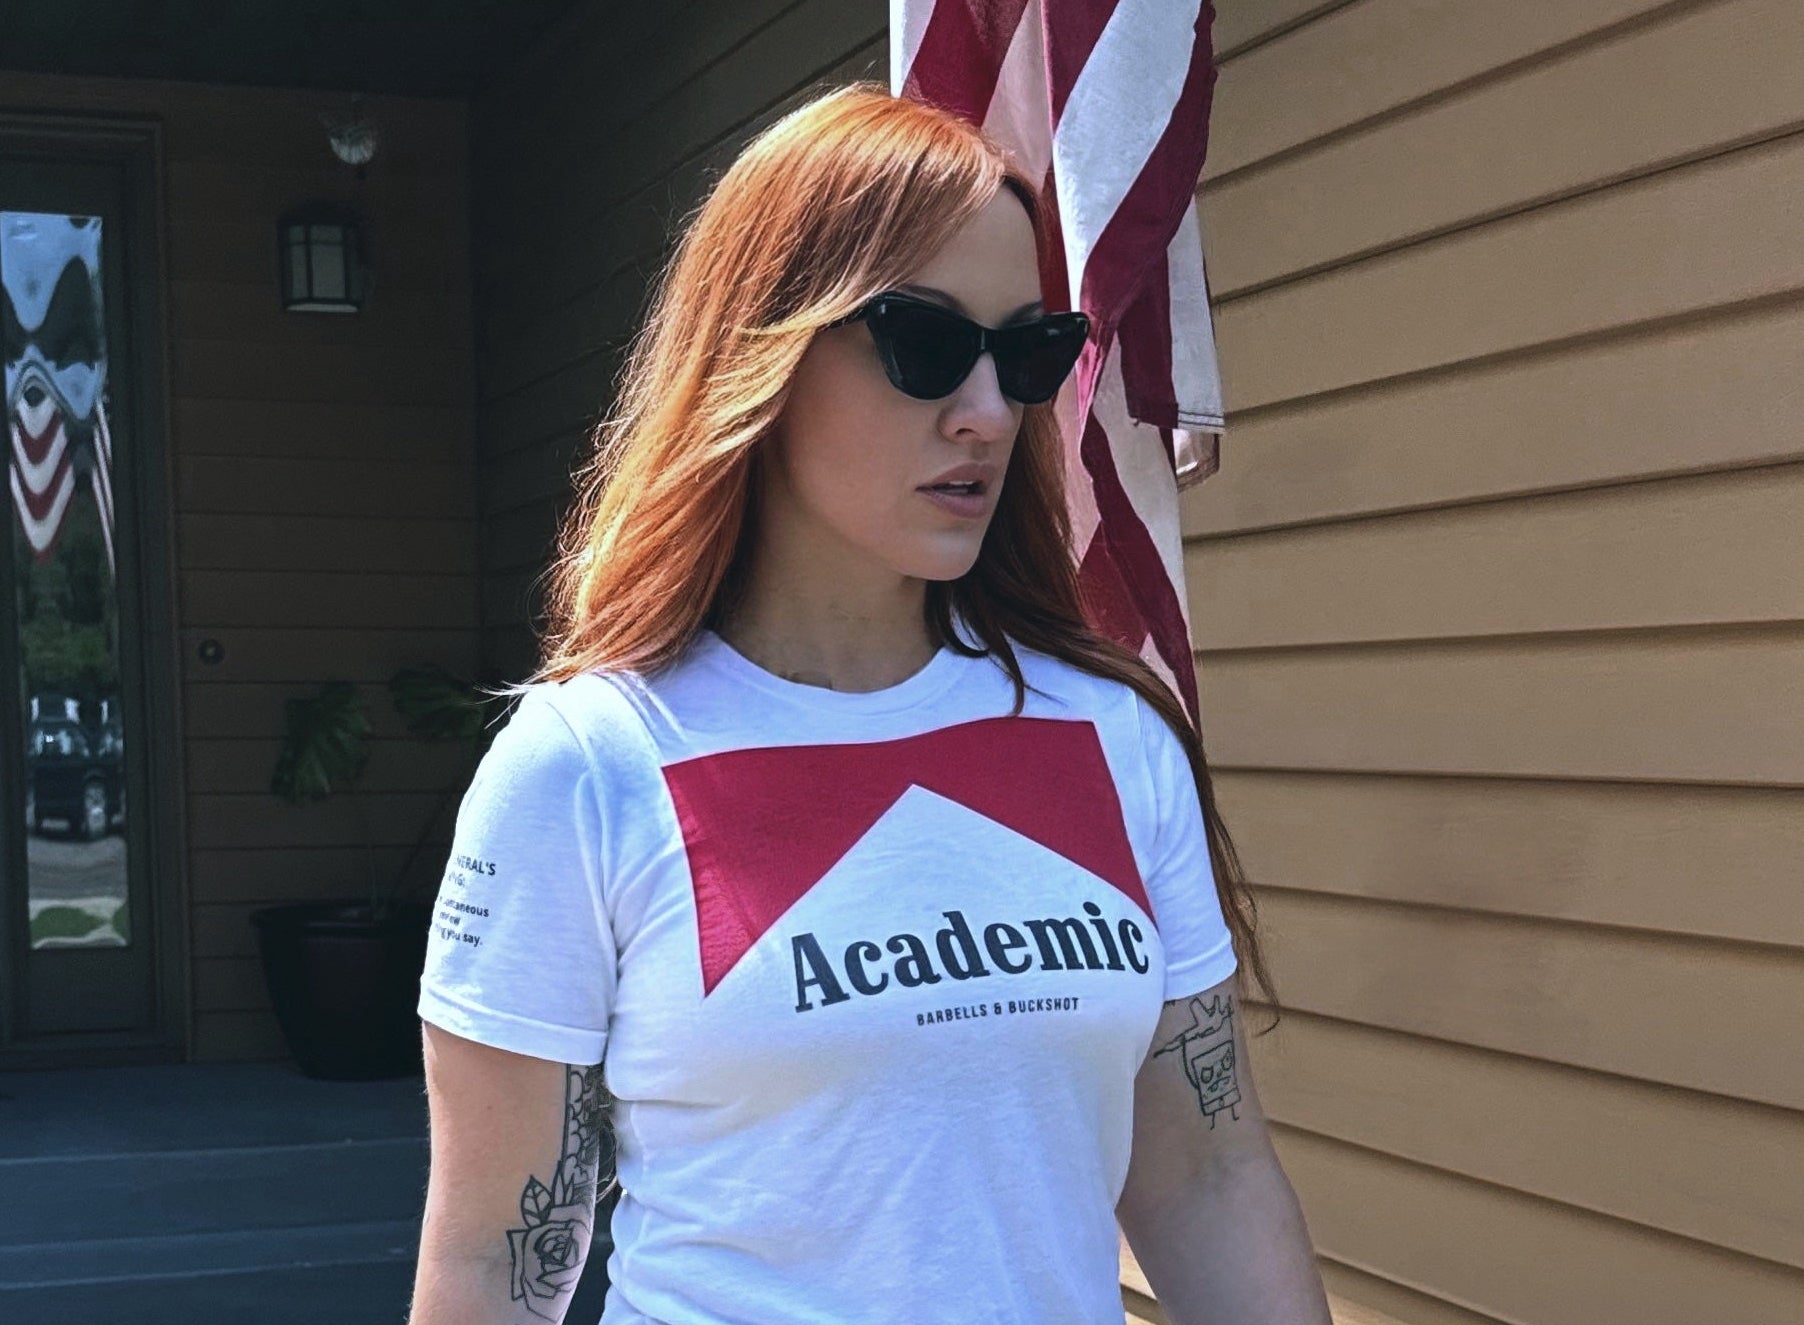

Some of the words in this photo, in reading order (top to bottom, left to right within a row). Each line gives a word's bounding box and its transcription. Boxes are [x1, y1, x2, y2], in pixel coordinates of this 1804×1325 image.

[790, 901, 1149, 1013] Academic
[916, 1003, 988, 1026] BARBELLS
[994, 1002, 1003, 1016] &
[1008, 997, 1080, 1014] BUCKSHOT
